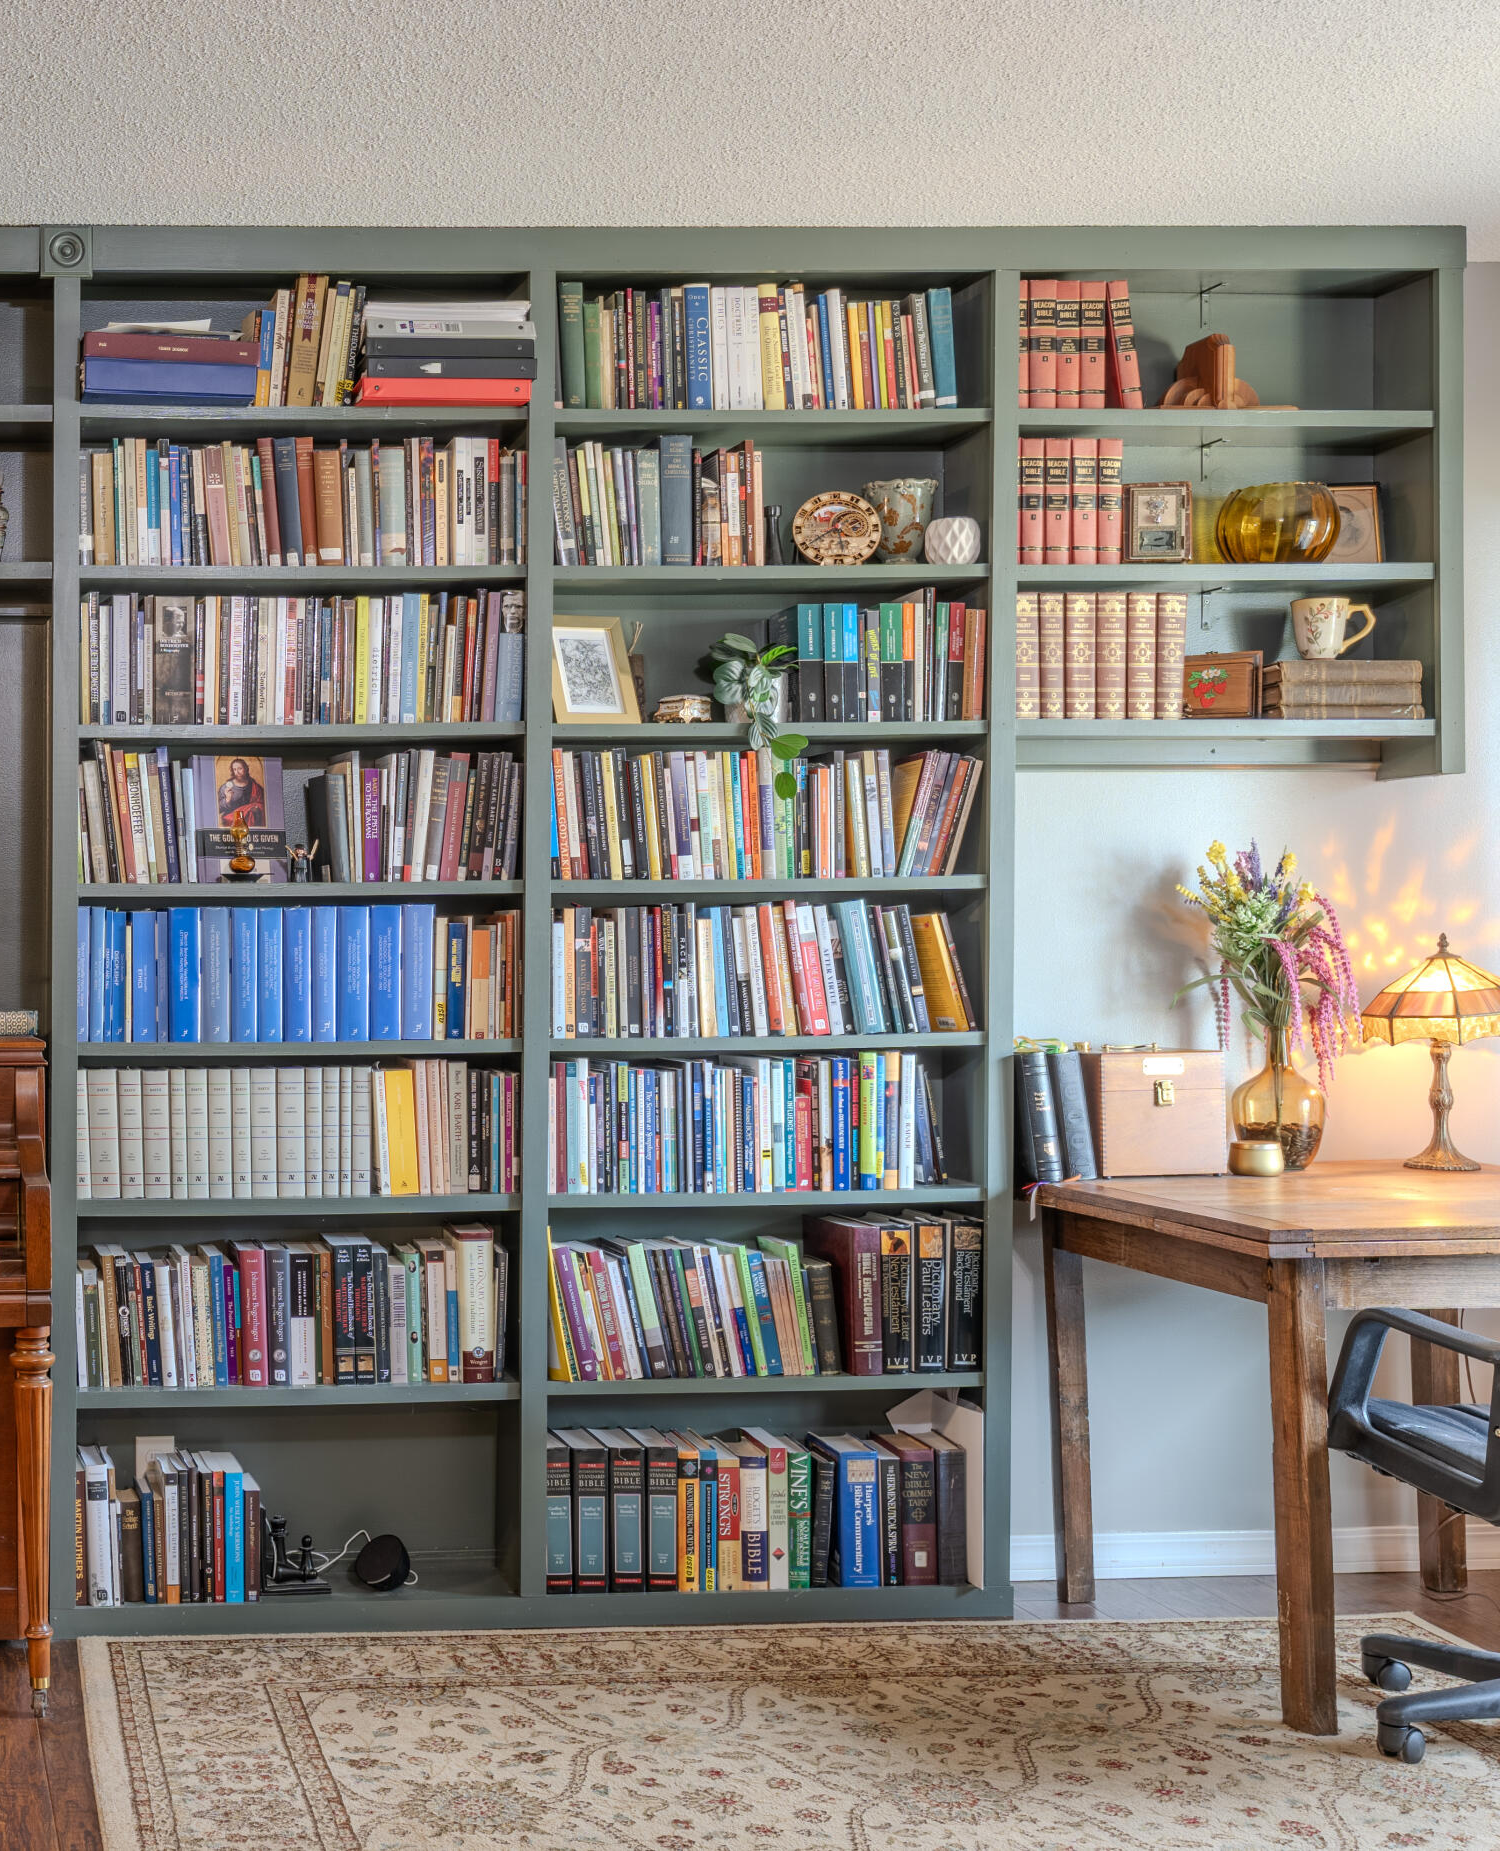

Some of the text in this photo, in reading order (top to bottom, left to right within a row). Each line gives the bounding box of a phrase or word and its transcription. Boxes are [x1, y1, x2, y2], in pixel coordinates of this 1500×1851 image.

[734, 297, 742, 337] DOCTRINE
[1059, 311, 1076, 319] BIBLE
[347, 328, 359, 368] THEOLOGY
[696, 317, 708, 382] CLASSIC
[1100, 460, 1121, 468] BEACON
[557, 469, 571, 533] FOUNDATIONS OF
[867, 629, 879, 678] WORKS OF LOVE
[129, 781, 143, 834] BONHOEFFER
[366, 782, 372, 791] TO
[209, 834, 221, 842] THE
[260, 835, 279, 843] GIVEN
[556, 768, 569, 867] SEXISM GOD TALK
[105, 1263, 116, 1328] HOLY TEACHING
[251, 1271, 260, 1300] Johannes
[276, 1271, 284, 1300] Johannes
[863, 1252, 873, 1336] BIBLE ENCYCLOPEDIA
[891, 1256, 900, 1334] New Testament
[930, 1260, 942, 1323] Dictionary
[954, 1251, 964, 1301] Background
[963, 1251, 972, 1314] New Testament
[970, 1251, 981, 1293] Dictionary
[144, 1270, 155, 1340] Anselm Basic Writings
[567, 1280, 587, 1351] TRANSFORMING MISSION
[900, 1256, 911, 1341] Dictionary Later
[922, 1260, 933, 1335] Paul Letters
[578, 1479, 605, 1487] BIBLE
[614, 1476, 641, 1486] BIBLE
[718, 1473, 731, 1536] STRONG'S
[789, 1455, 808, 1510] VINE'S
[864, 1485, 874, 1526] Harper's
[887, 1473, 897, 1529] HERMENEUTICAL
[747, 1533, 762, 1575] BIBLE
[853, 1485, 863, 1574] Bible Commentary
[887, 1530, 898, 1553] SPIRAL
[685, 1555, 694, 1577] USED
[706, 1569, 714, 1590] USED
